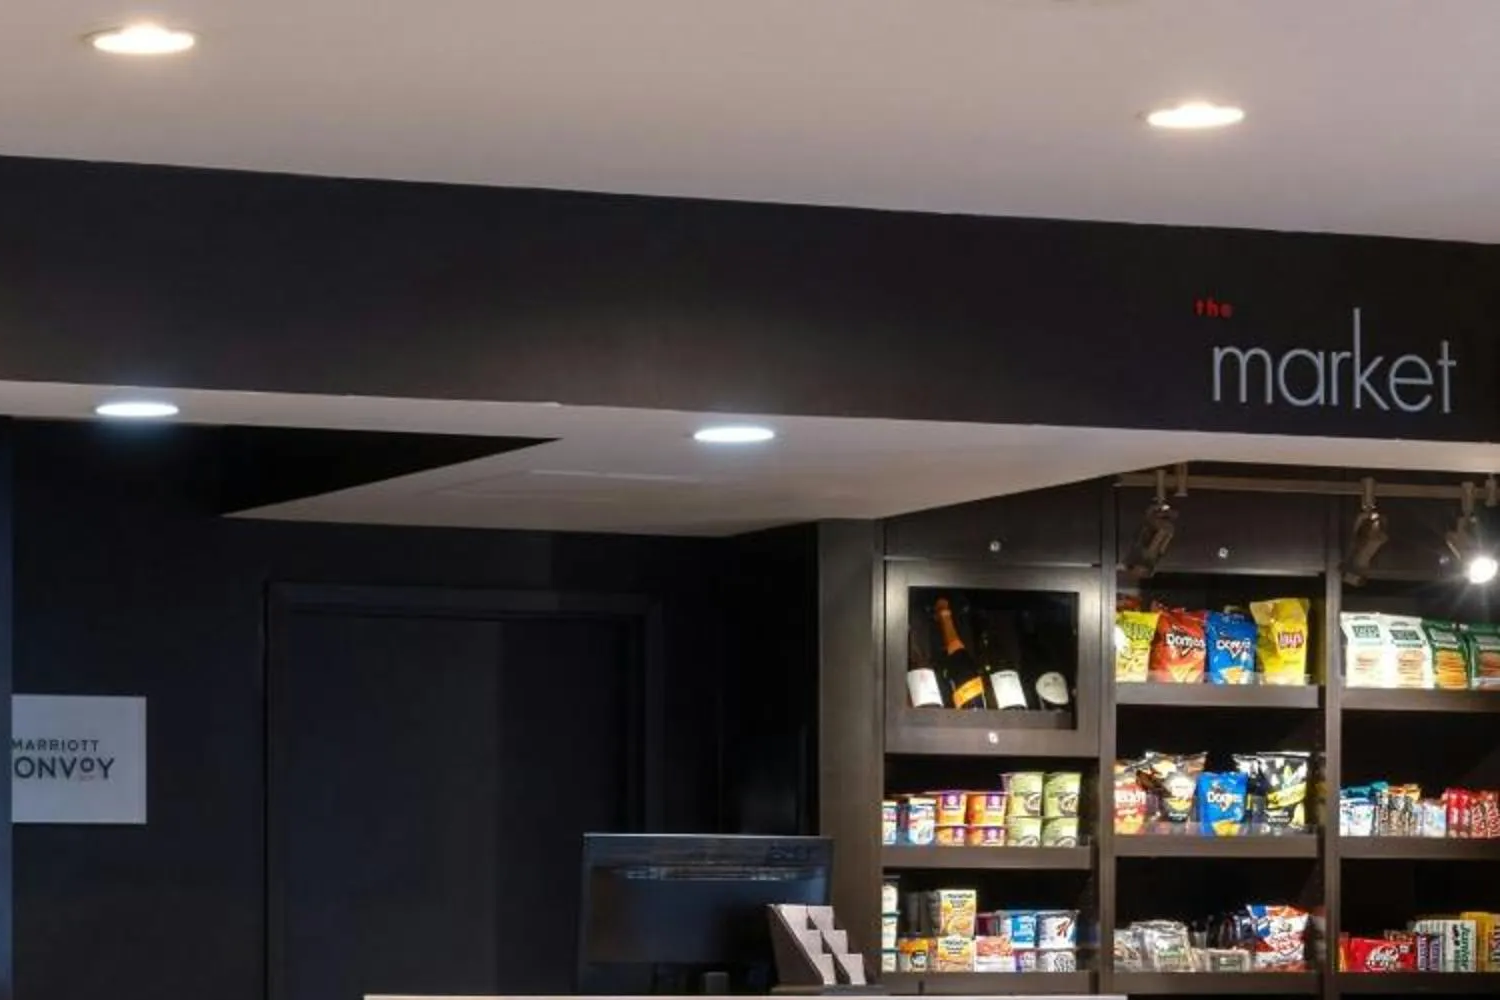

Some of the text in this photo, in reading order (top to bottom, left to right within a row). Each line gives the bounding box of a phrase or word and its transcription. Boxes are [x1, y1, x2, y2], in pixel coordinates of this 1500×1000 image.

[1193, 298, 1233, 318] the
[1213, 307, 1457, 414] market
[13, 756, 115, 780] ONVOY
